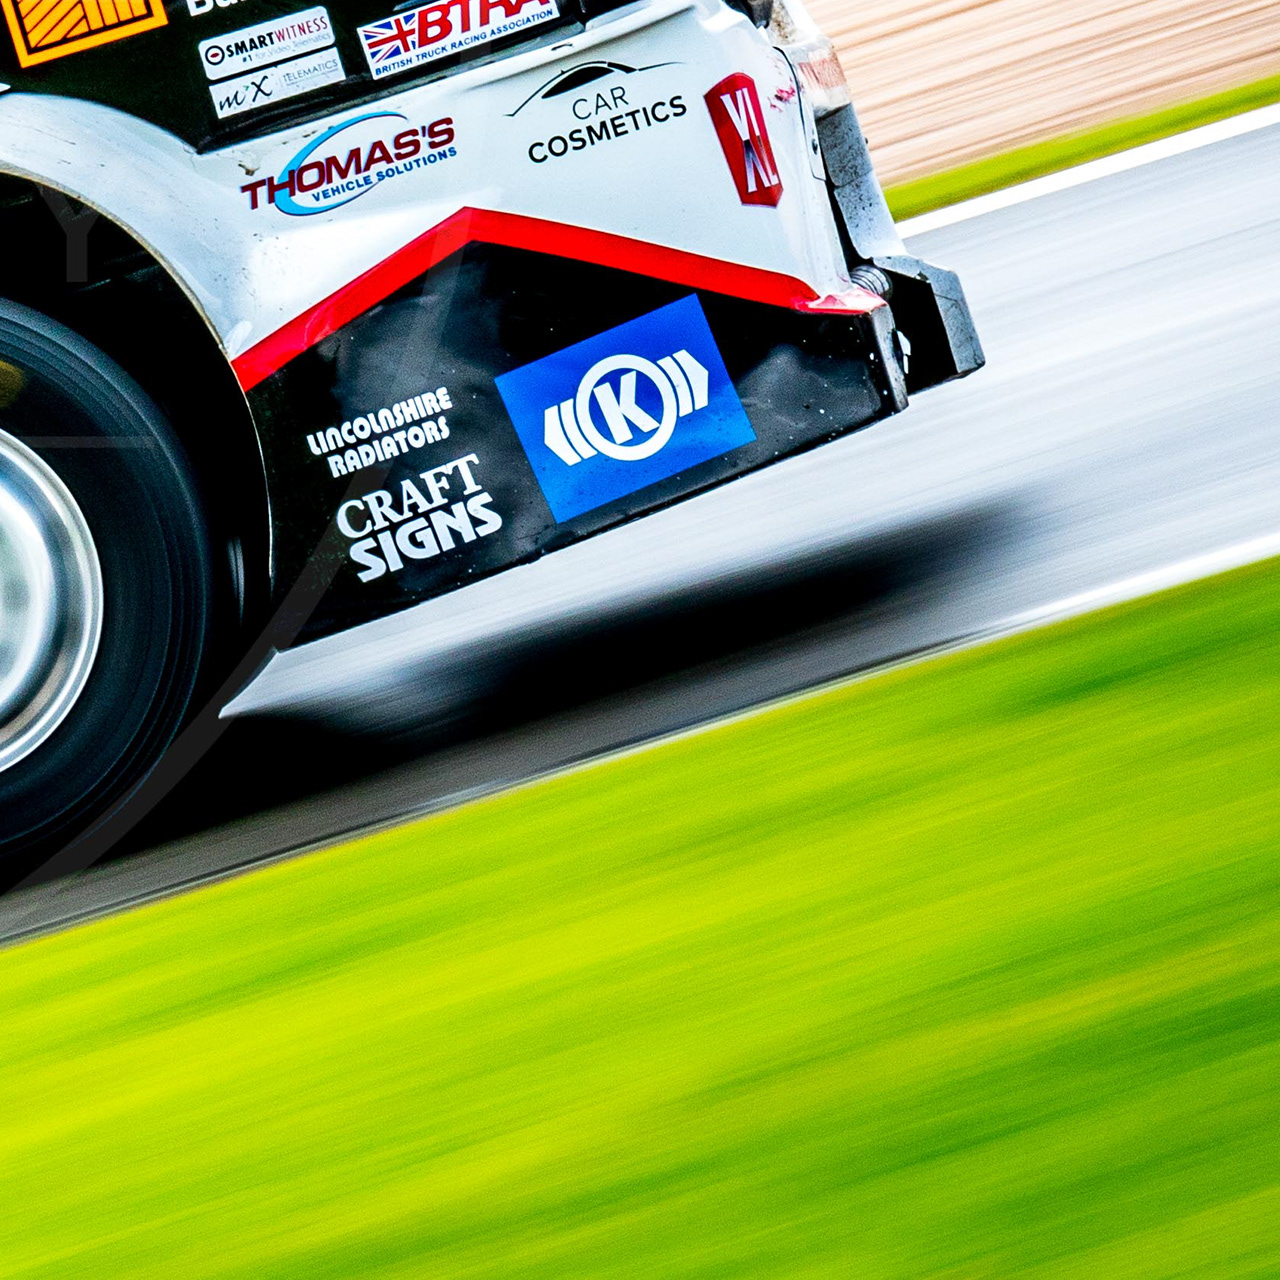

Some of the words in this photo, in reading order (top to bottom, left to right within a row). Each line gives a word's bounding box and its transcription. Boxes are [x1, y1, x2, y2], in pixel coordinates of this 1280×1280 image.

[282, 59, 338, 83] TELEMATICS
[375, 57, 413, 76] BRITISH
[416, 44, 448, 62] TRUCK
[450, 32, 487, 50] RACING
[490, 9, 554, 38] ASSOCIATION
[528, 95, 687, 164] COSMETICS
[572, 86, 629, 120] CAR
[240, 117, 455, 210] THOMAS'S
[312, 176, 373, 202] VEHICLE
[376, 146, 457, 181] SOLUTIONS
[719, 87, 780, 193] XL
[306, 387, 453, 456] LINCOLNSHIRE
[328, 417, 450, 479] RADIATORS
[336, 452, 483, 540] CRAFT
[348, 491, 503, 583] SIGNS
